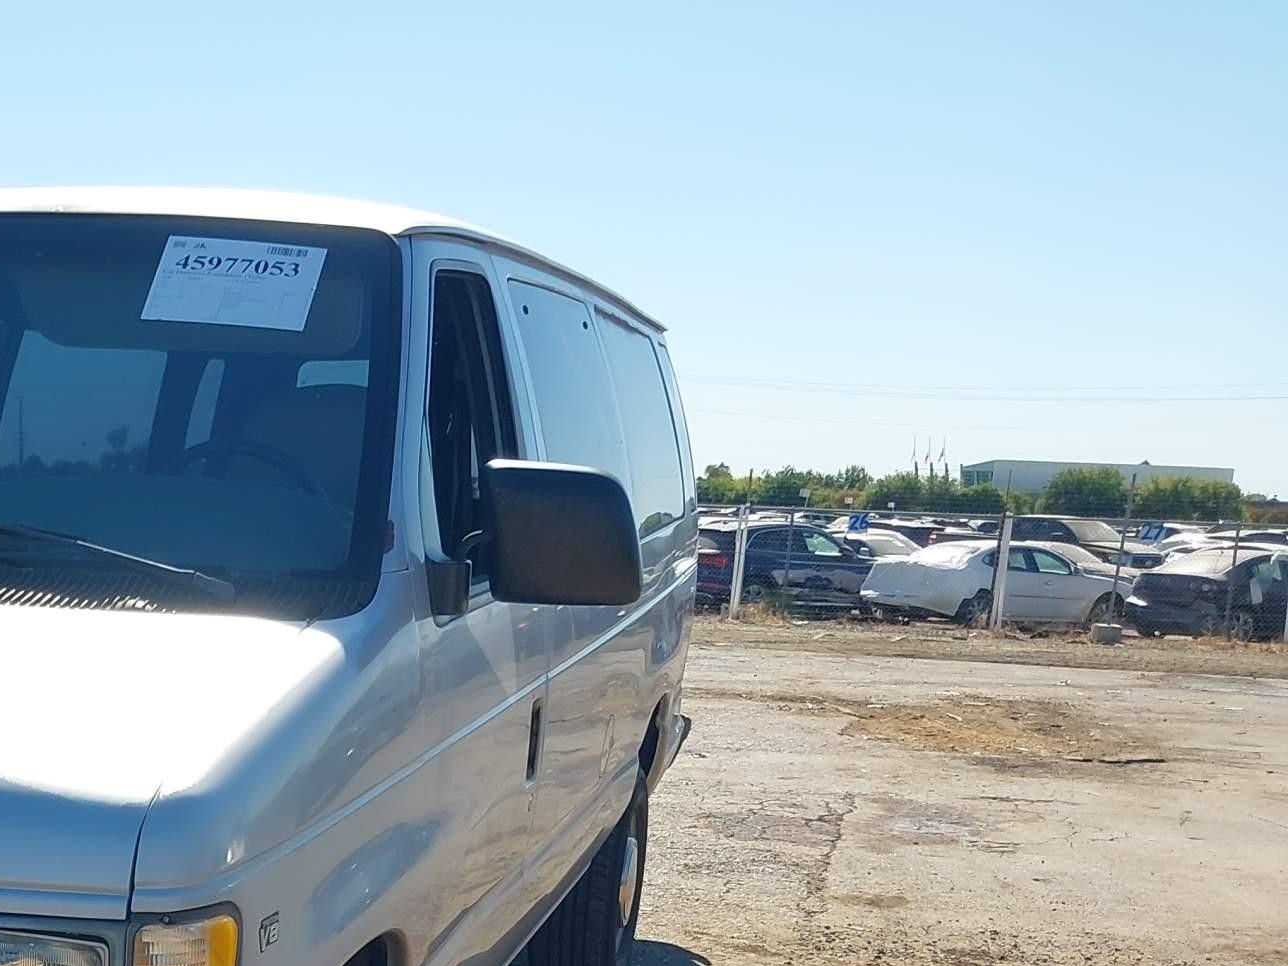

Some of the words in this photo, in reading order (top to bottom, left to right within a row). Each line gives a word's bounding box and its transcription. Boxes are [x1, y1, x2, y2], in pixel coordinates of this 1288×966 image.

[175, 253, 300, 278] 45977053
[849, 512, 869, 530] 26
[1141, 523, 1164, 541] 27
